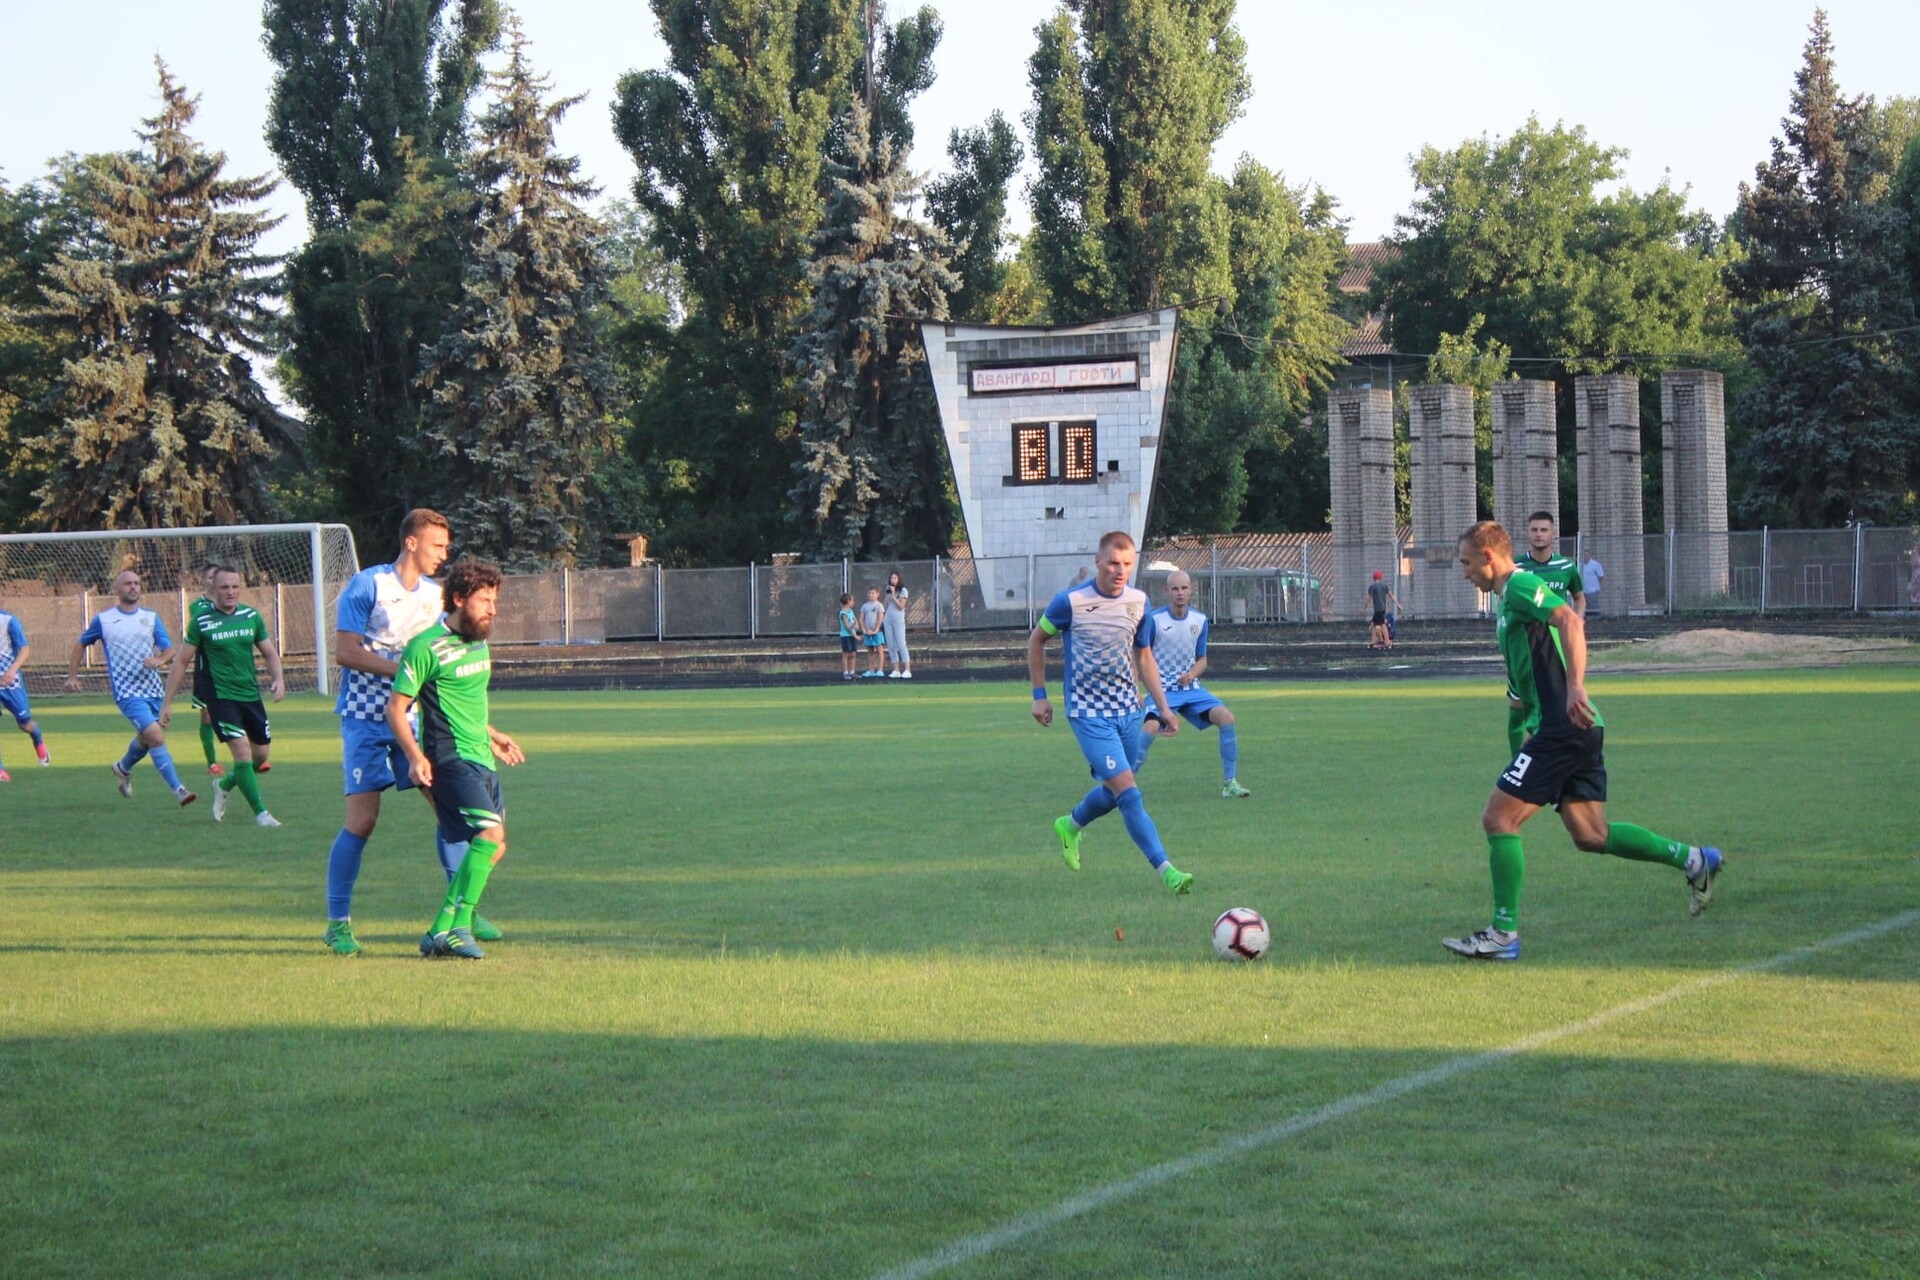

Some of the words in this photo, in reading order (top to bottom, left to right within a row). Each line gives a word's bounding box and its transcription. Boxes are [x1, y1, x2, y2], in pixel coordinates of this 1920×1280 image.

[1068, 366, 1122, 382] ГОСТИ
[1019, 428, 1046, 480] 8
[1066, 427, 1092, 479] 0
[1105, 755, 1117, 770] 6
[1509, 752, 1532, 780] 9
[352, 767, 363, 785] 9
